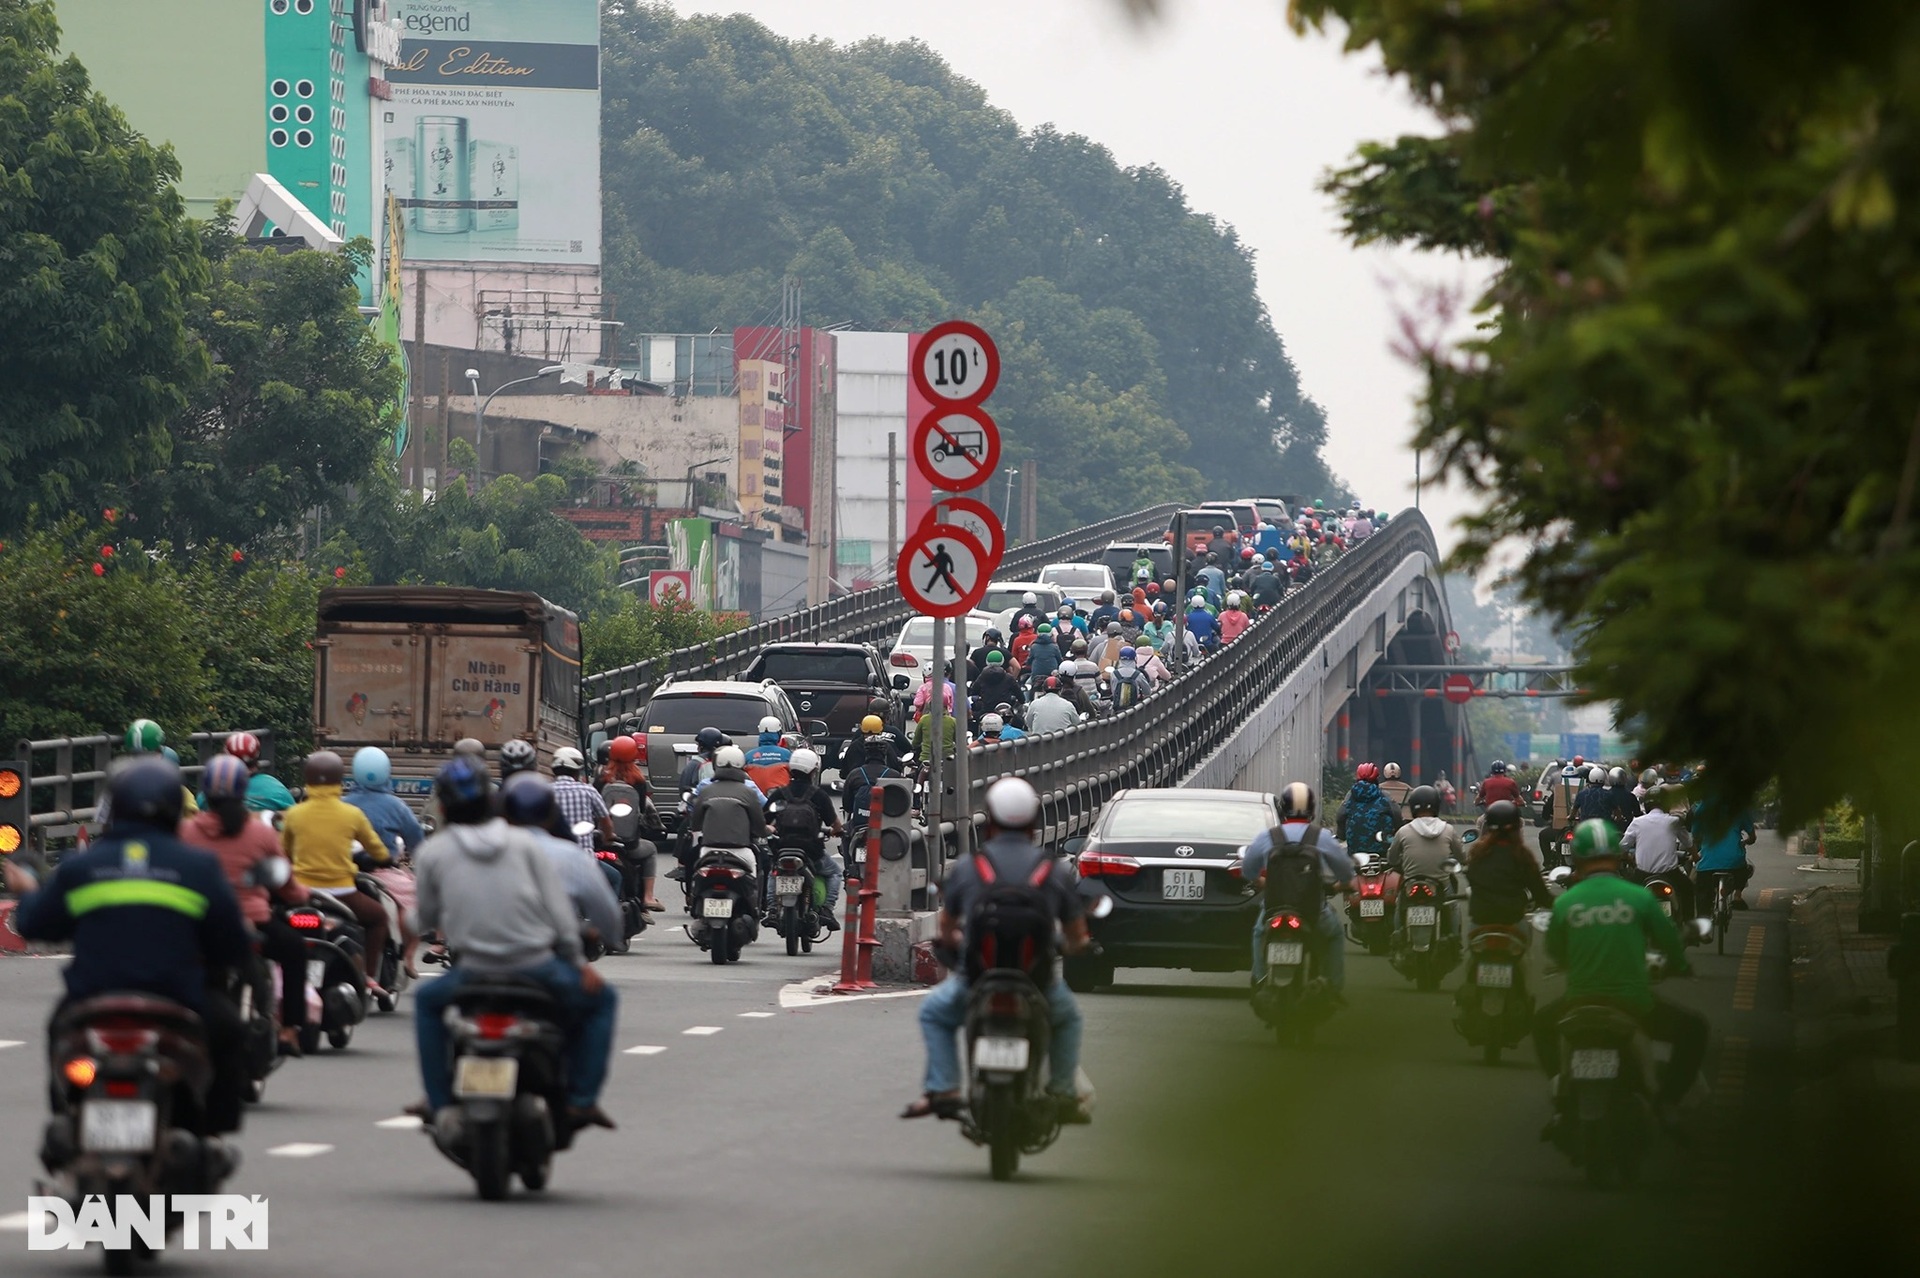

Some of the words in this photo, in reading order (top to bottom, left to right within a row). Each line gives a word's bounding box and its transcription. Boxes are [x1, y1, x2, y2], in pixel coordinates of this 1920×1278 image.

[406, 4, 430, 12] TRUNG
[438, 46, 535, 76] Edition
[934, 348, 968, 385] 10
[1173, 872, 1195, 884] 61A
[1165, 885, 1203, 898] 271.50
[1567, 898, 1636, 928] Grab
